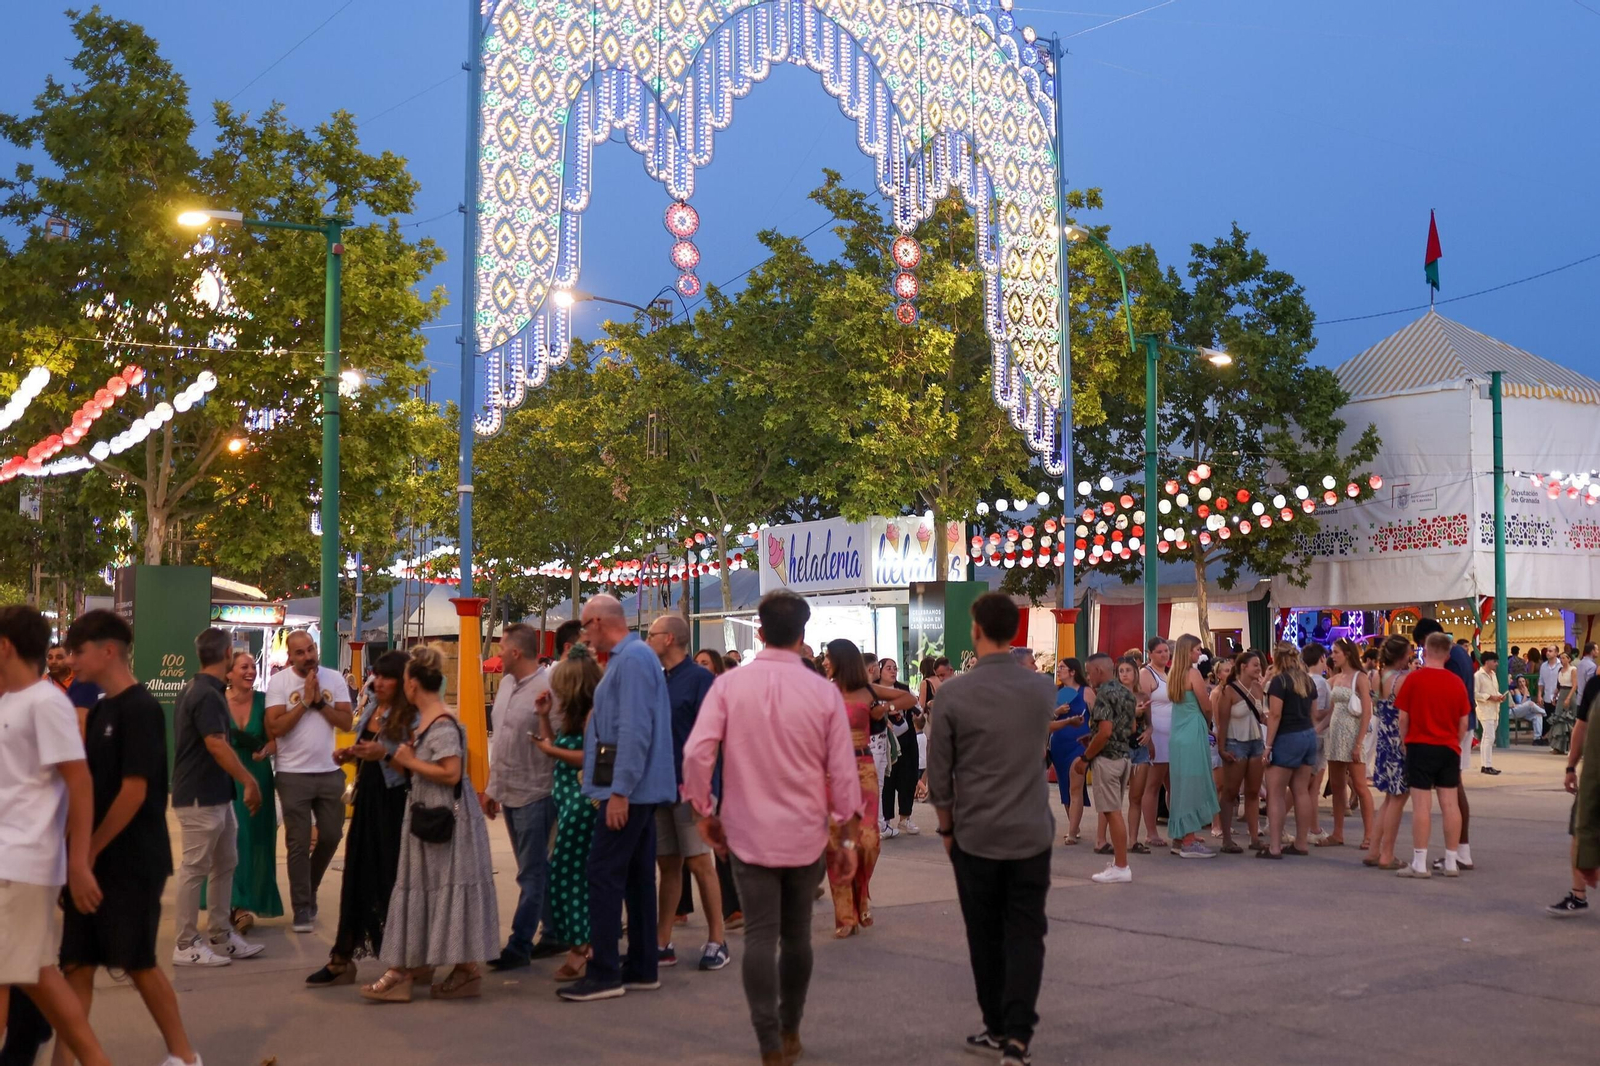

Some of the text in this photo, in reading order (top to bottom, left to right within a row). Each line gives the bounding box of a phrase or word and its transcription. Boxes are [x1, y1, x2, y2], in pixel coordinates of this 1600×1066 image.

[1511, 489, 1538, 497] Diputación
[1520, 496, 1540, 504] Granada
[788, 529, 863, 584] heladería
[876, 533, 961, 584] helads
[161, 653, 185, 667] 100
[159, 666, 187, 677] años
